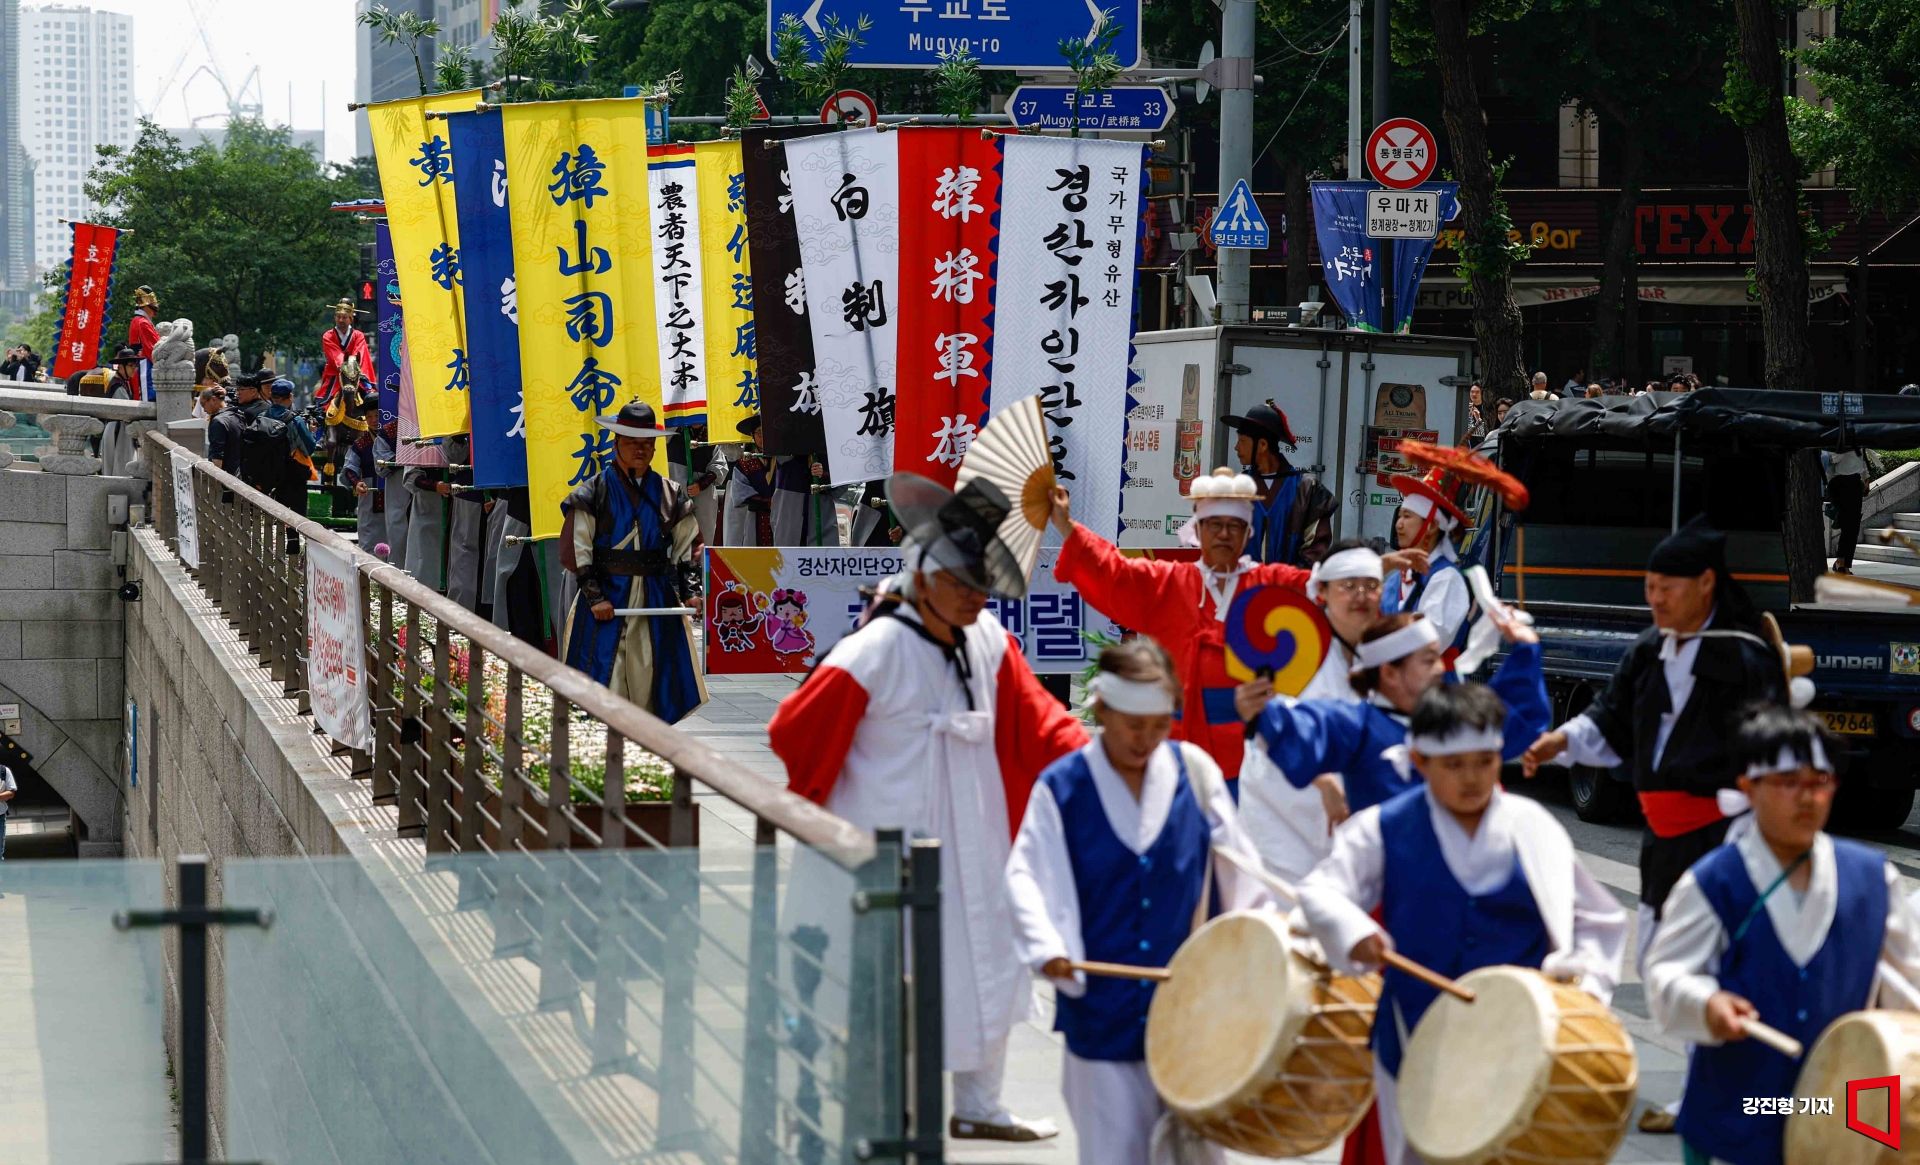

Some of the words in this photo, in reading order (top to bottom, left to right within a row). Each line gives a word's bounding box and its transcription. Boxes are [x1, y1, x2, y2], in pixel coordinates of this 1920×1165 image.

[909, 33, 1000, 55] Mugyo-ro
[1020, 102, 1036, 115] 37
[1063, 93, 1116, 109] 무교로
[1143, 102, 1160, 117] 33
[1040, 114, 1099, 128] Mugy-ro
[1379, 147, 1424, 159] 통행금지
[1377, 197, 1428, 214] 우마차
[1371, 218, 1399, 232] 청계광장
[1408, 219, 1434, 232] 청계2가
[1102, 166, 1129, 307] 국가무형유산
[1214, 233, 1265, 246] 횡단보도
[1530, 220, 1583, 250] Bar
[657, 182, 699, 390] 農者天下之大本
[1817, 655, 1883, 670] UNDAI
